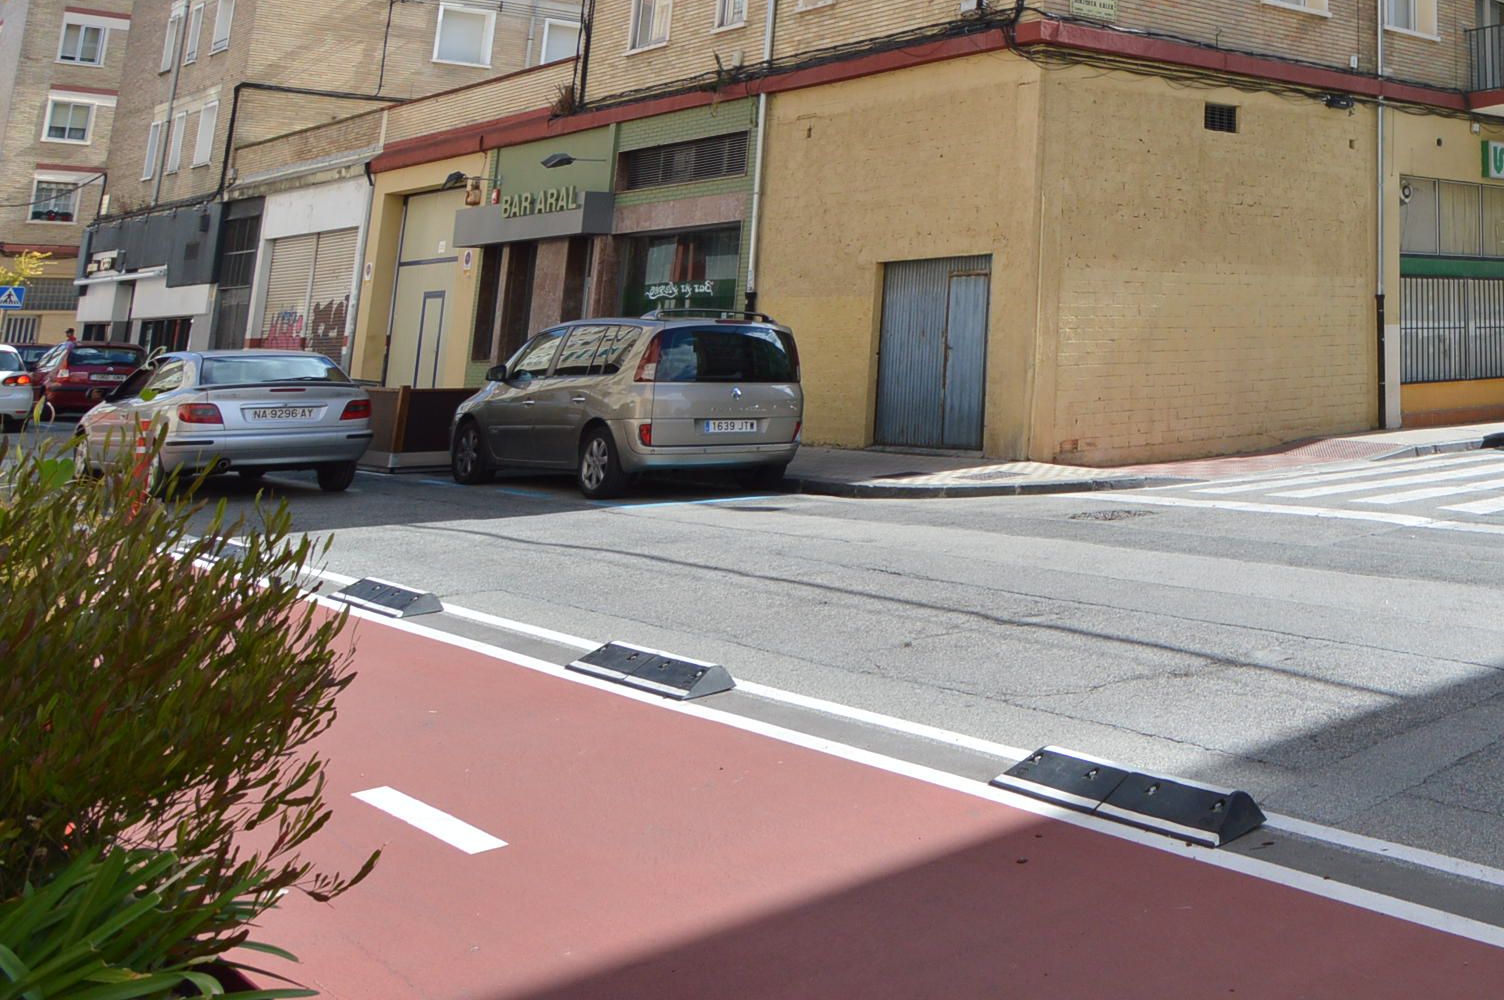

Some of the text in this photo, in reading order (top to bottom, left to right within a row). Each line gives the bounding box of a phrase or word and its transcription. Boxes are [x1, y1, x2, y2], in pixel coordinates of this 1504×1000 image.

[502, 185, 577, 218] BAR ARAL
[712, 421, 735, 431] 1639
